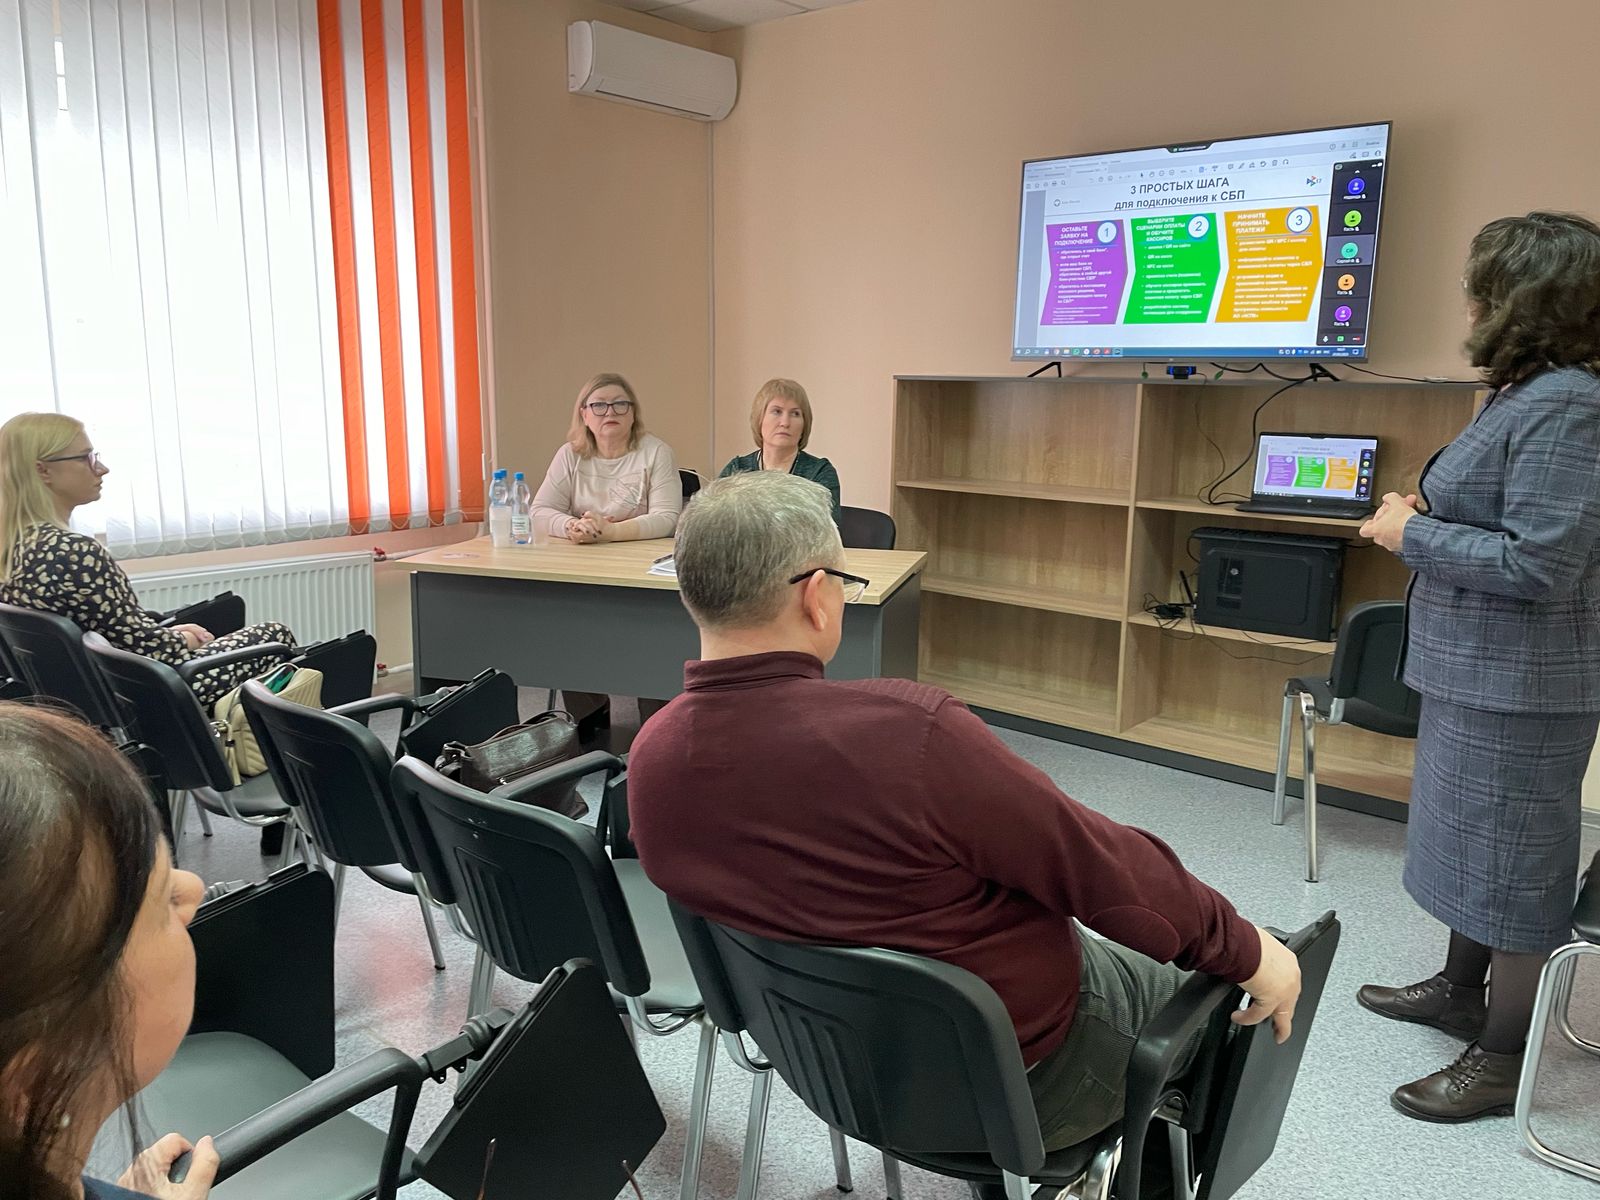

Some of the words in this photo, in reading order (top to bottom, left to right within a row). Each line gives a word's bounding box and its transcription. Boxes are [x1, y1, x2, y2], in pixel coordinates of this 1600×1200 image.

[1130, 186, 1136, 194] 3
[1140, 180, 1194, 194] ПРОСТЫХ
[1196, 178, 1230, 189] ШАГА
[1114, 200, 1134, 210] для
[1136, 194, 1208, 208] подключения
[1220, 190, 1245, 201] СБП
[1195, 221, 1202, 231] 2
[1296, 215, 1303, 226] 3
